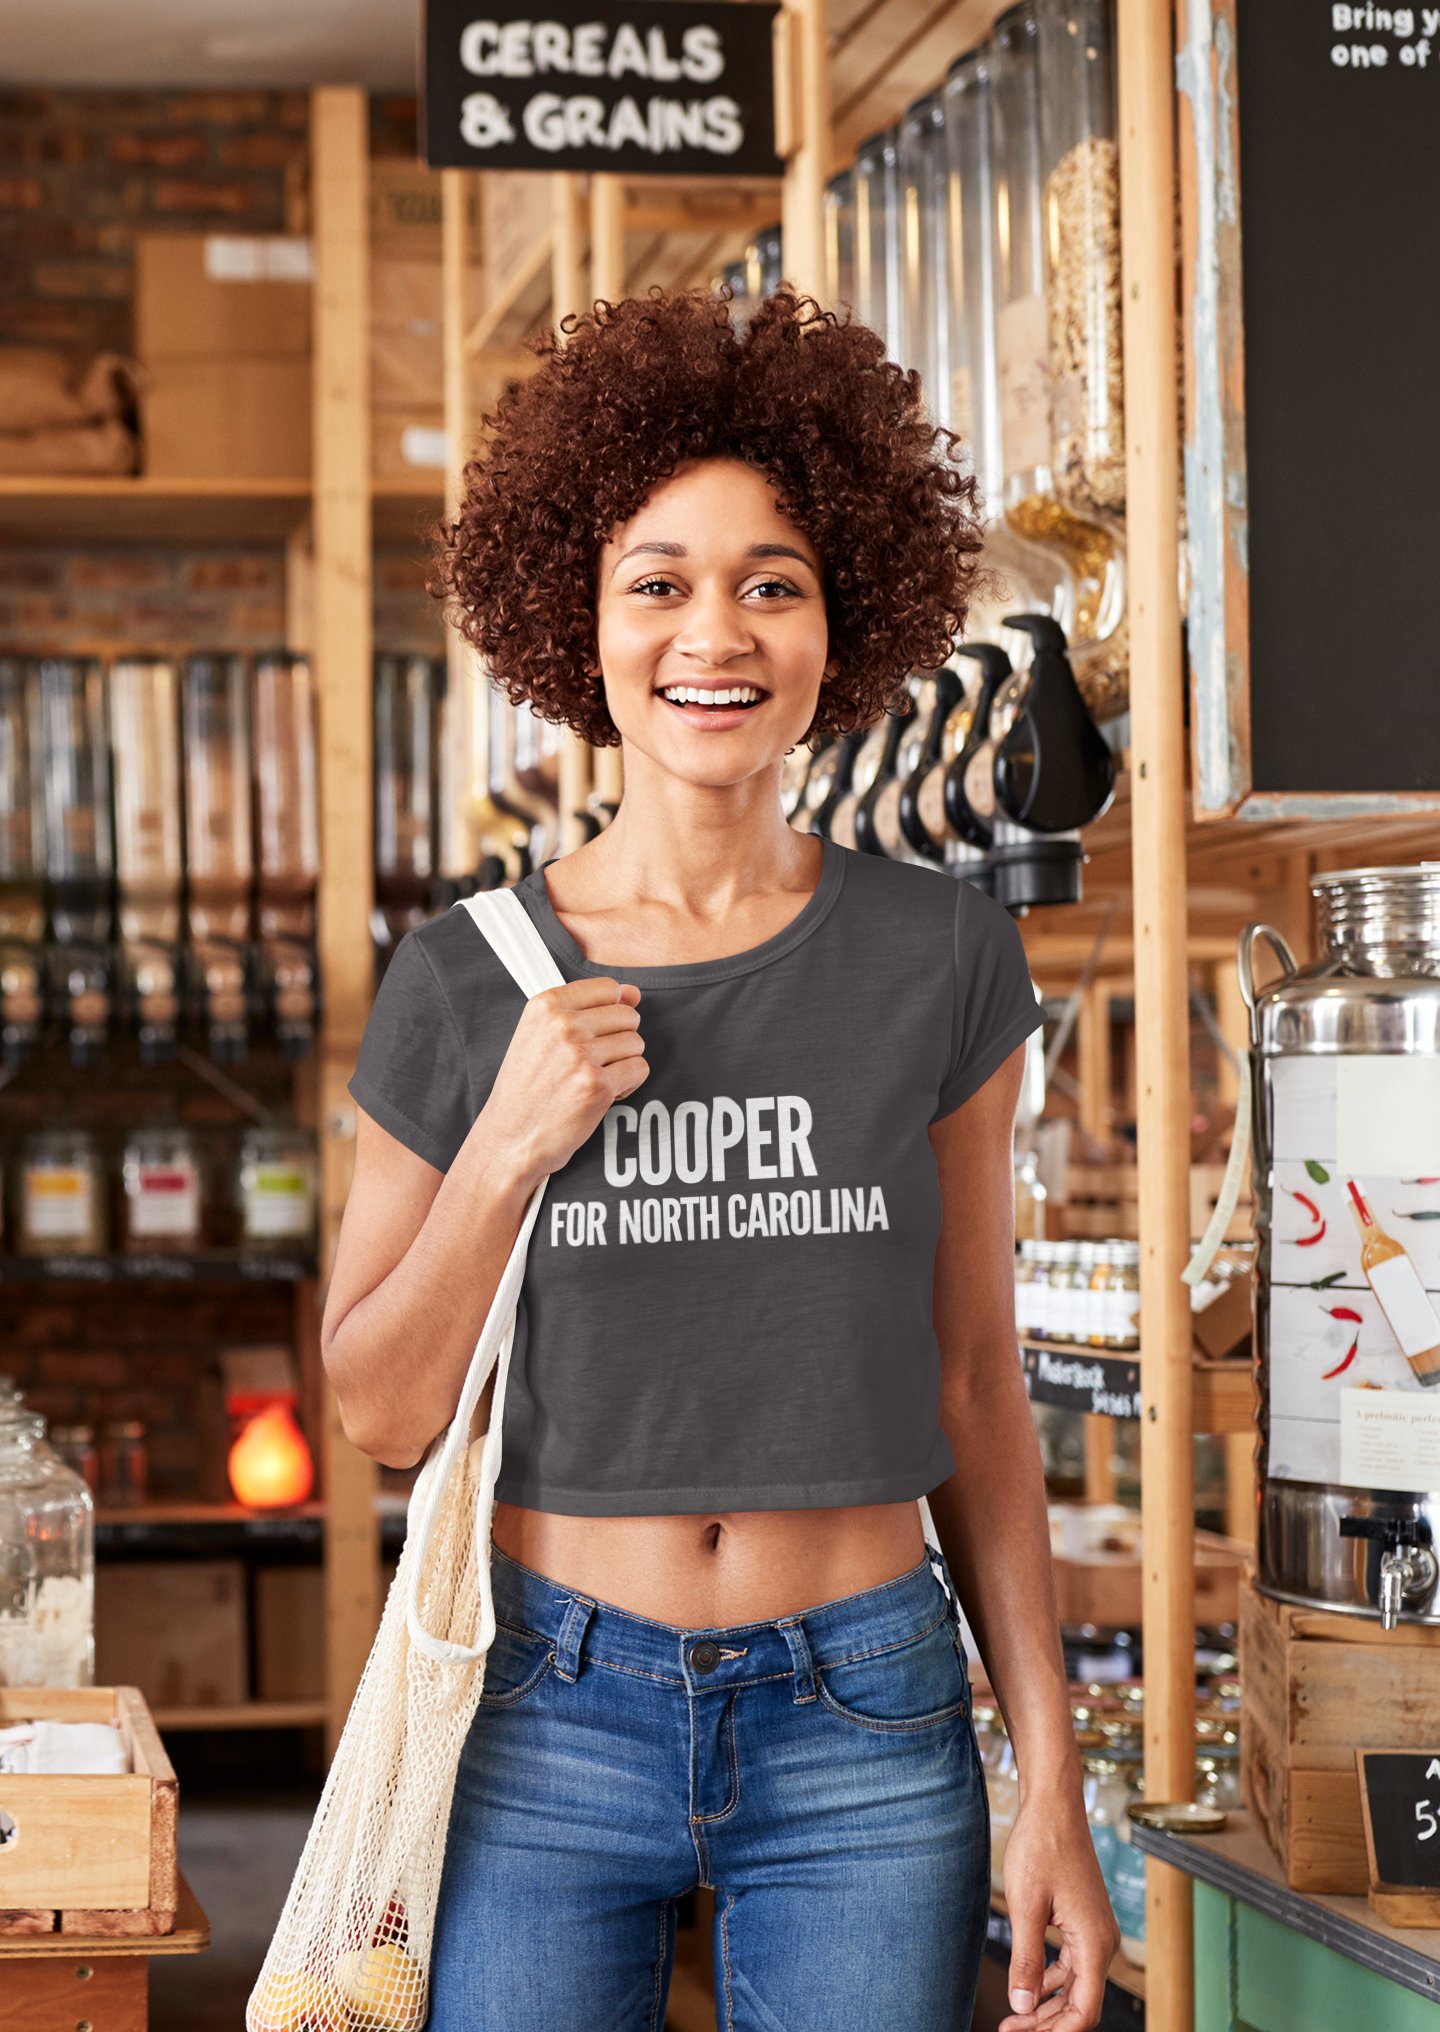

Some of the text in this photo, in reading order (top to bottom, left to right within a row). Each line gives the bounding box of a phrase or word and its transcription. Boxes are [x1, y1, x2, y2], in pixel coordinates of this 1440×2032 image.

[1332, 0, 1415, 38] Bring
[459, 19, 725, 83] CEREALS
[1330, 37, 1431, 69] one of
[459, 91, 744, 155] & GRAINS
[603, 1095, 819, 1188] COOPER
[550, 1186, 890, 1248] FOR NORTH CAROLINA
[1364, 1410, 1408, 1423] prebiotic
